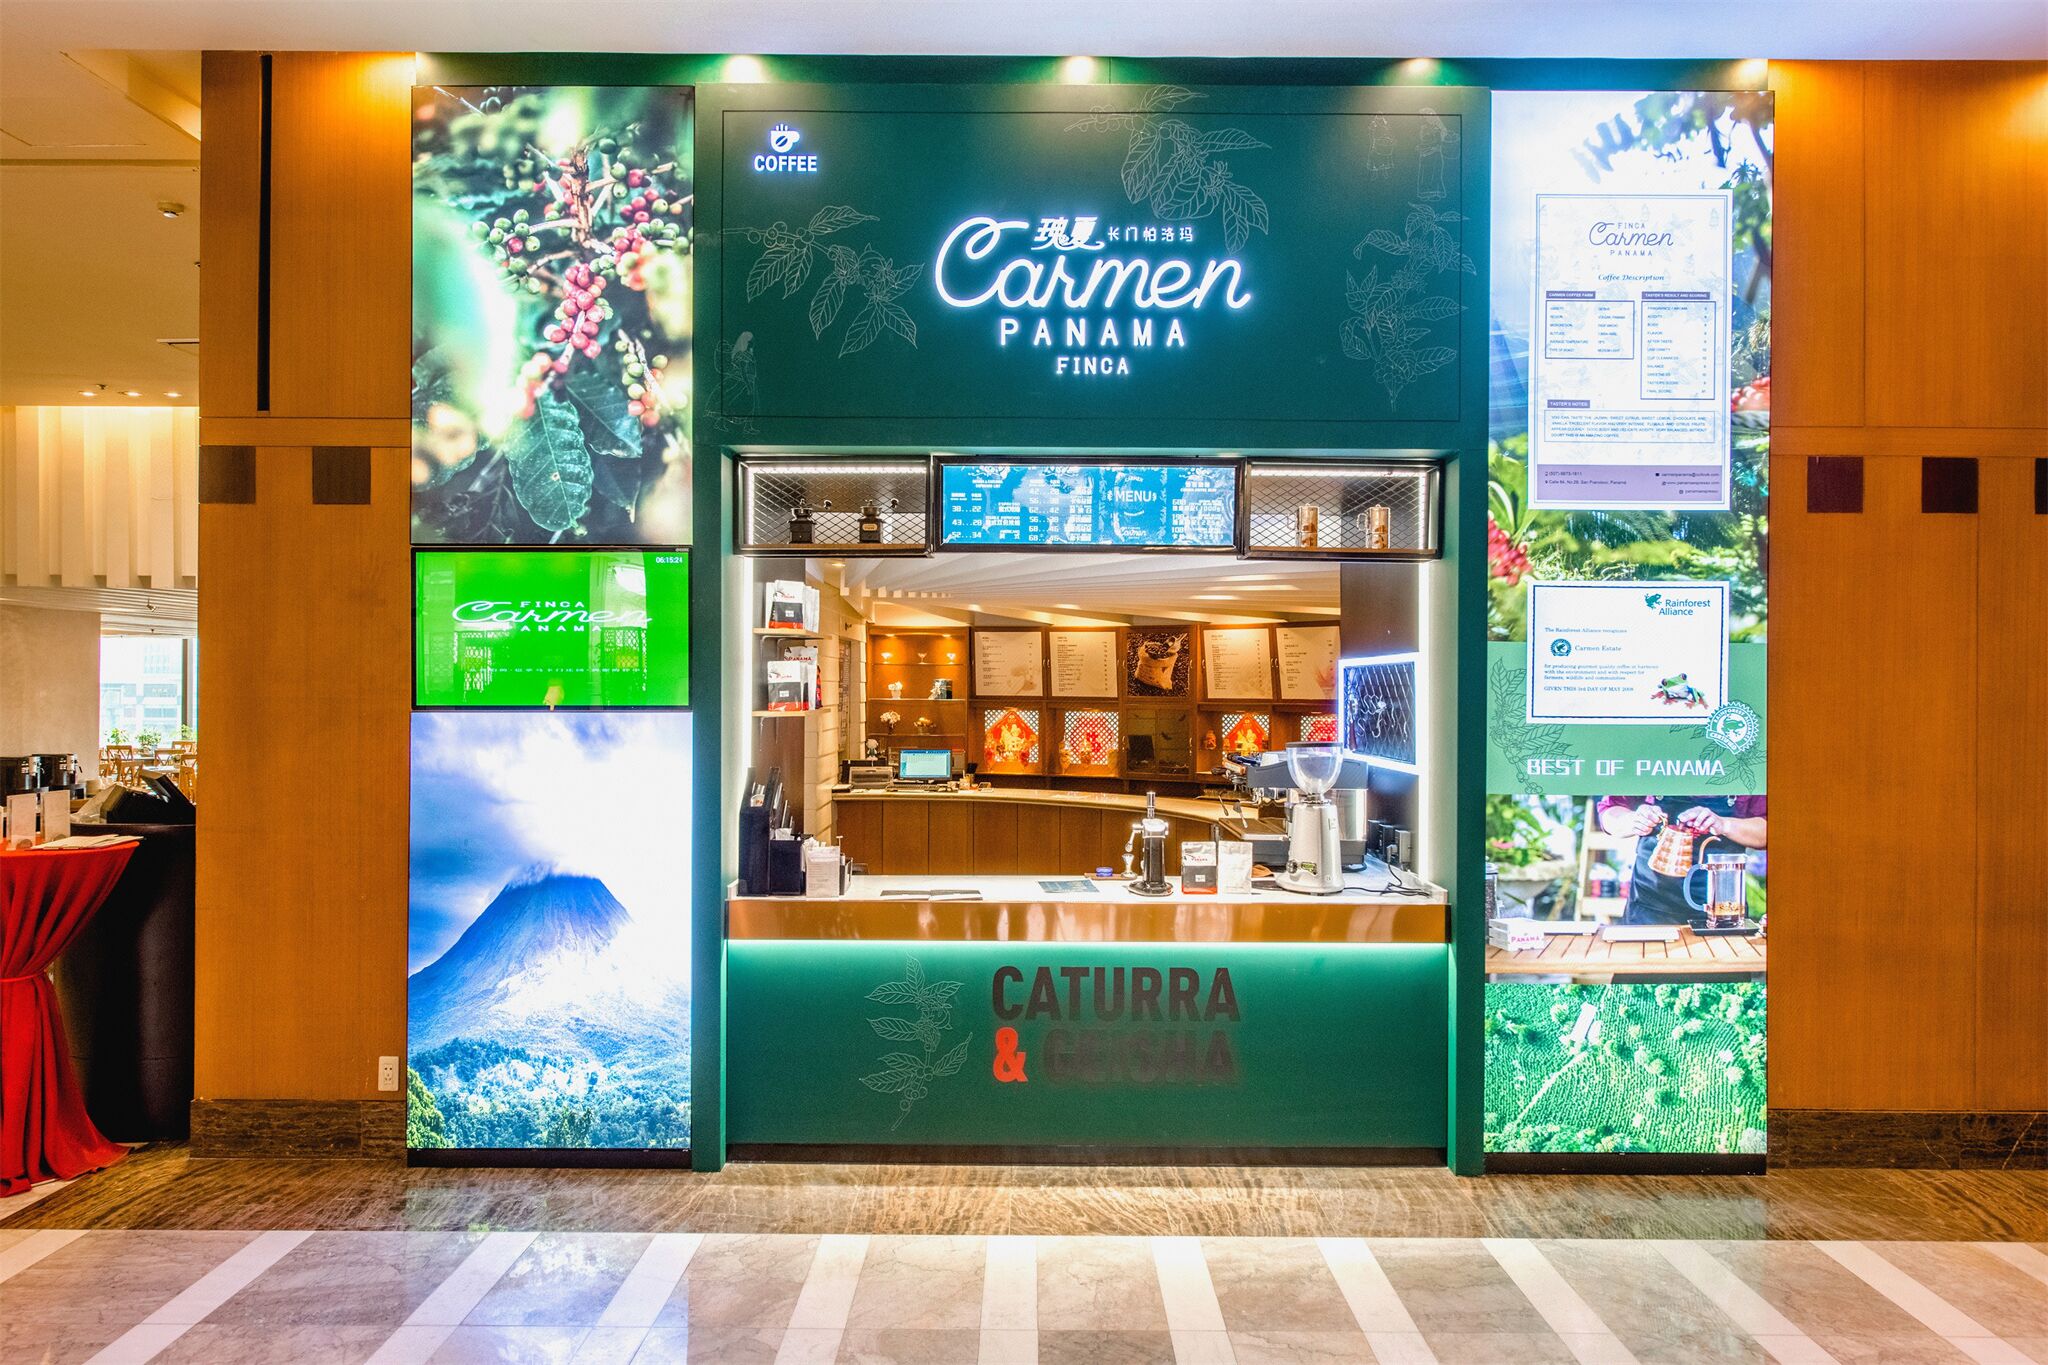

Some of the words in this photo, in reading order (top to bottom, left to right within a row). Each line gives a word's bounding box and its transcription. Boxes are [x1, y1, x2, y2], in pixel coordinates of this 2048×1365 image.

[754, 155, 817, 172] COFFEE
[1589, 221, 1674, 246] Carmen
[935, 216, 1251, 309] Carmen
[1598, 273, 1620, 281] Coffee
[1622, 274, 1665, 283] Description
[1000, 318, 1185, 347] PANAMA
[1056, 356, 1129, 375] FINCA
[1115, 490, 1152, 502] MENU
[452, 600, 653, 623] Carmen
[1658, 607, 1694, 616] Alliance
[1664, 598, 1711, 608] Rainforest
[1527, 759, 1585, 776] BEST
[1596, 759, 1624, 776] OF
[1636, 759, 1726, 776] PANAMA
[992, 965, 1241, 1022] CATURRA
[993, 1026, 1028, 1083] &
